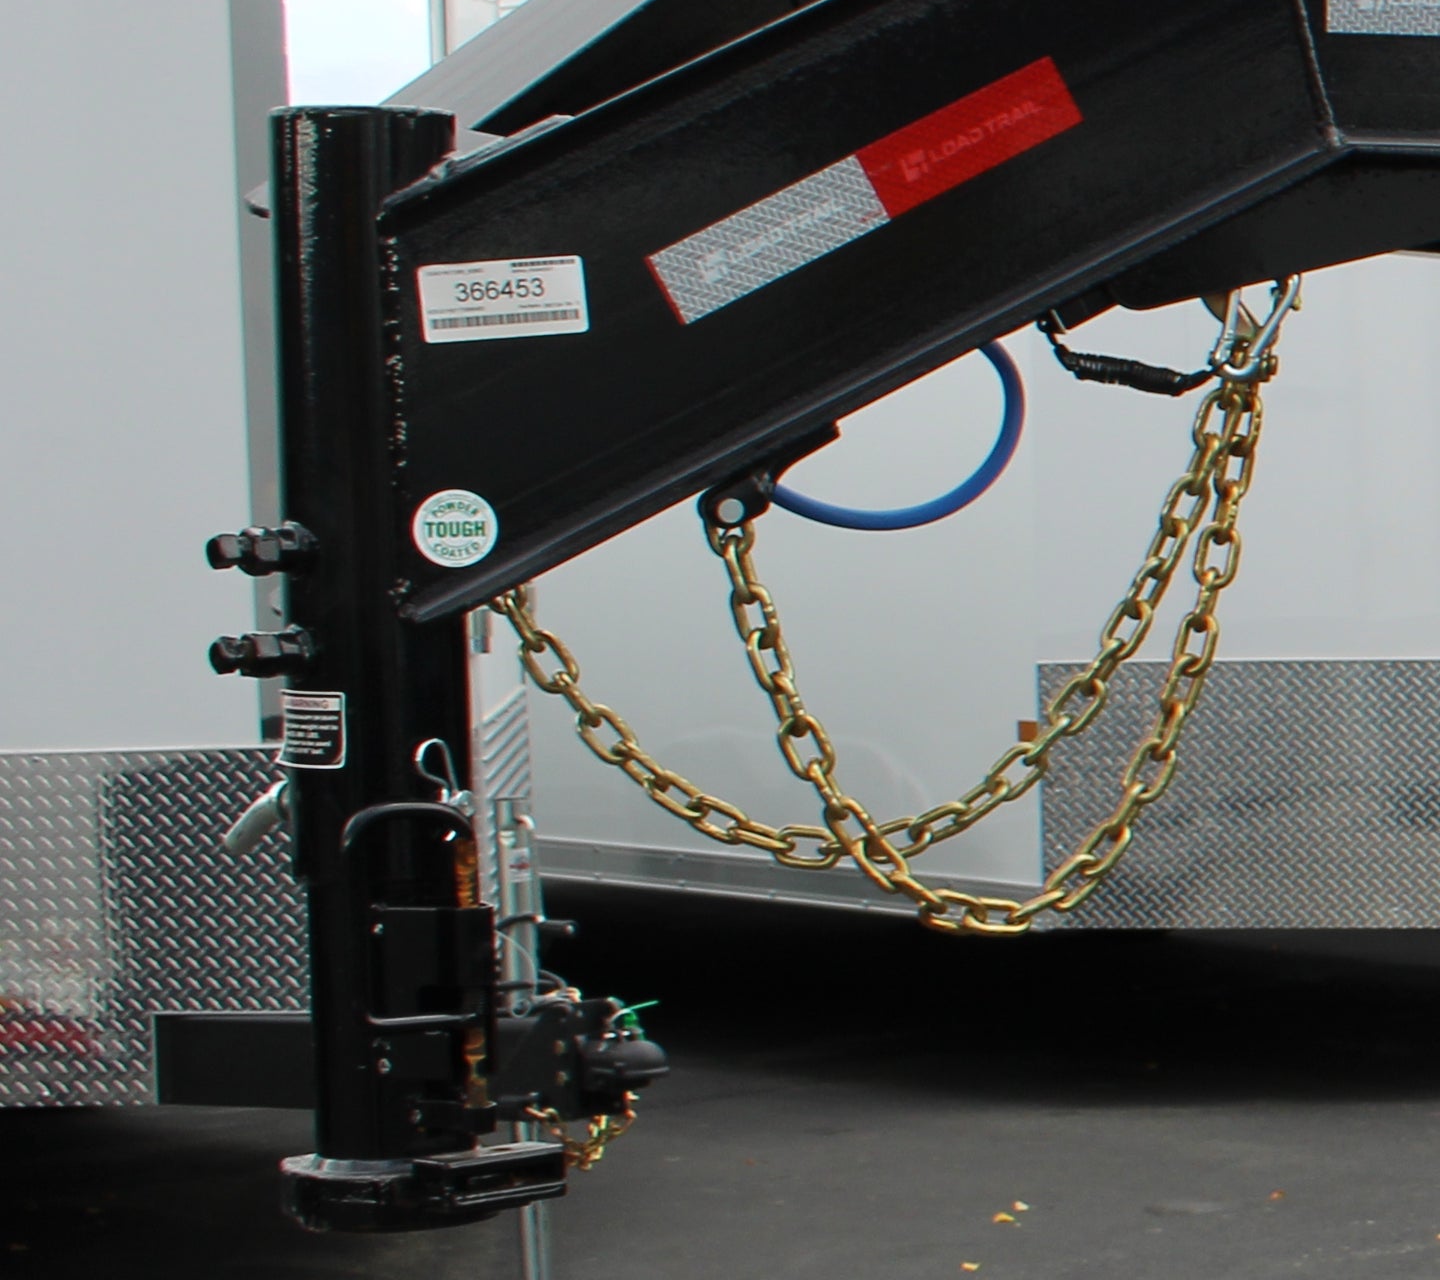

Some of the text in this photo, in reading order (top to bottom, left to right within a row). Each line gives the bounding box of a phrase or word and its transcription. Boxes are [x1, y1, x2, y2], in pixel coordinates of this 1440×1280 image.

[928, 101, 1045, 161] LOAD TRAIL
[455, 277, 545, 302] 366453
[423, 521, 486, 538] TOUGH
